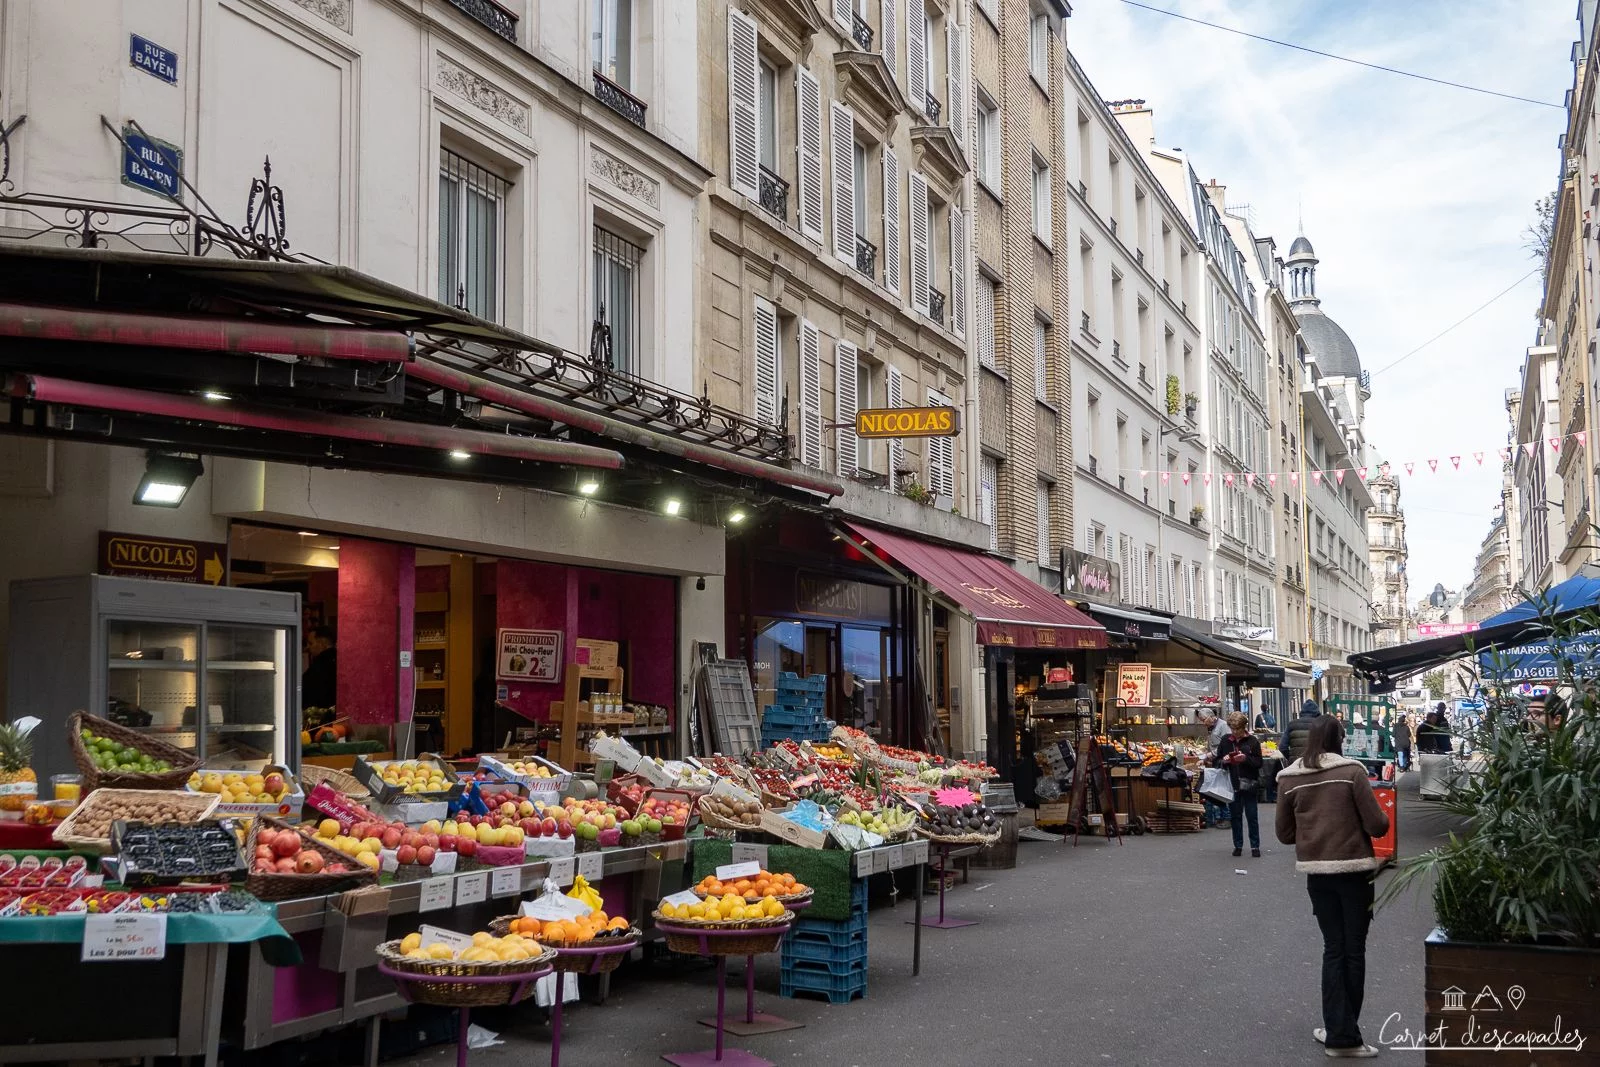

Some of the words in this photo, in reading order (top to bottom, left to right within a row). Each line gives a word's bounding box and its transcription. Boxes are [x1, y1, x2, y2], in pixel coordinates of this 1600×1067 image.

[144, 43, 166, 61] RUE
[135, 51, 174, 79] BAYEN
[141, 147, 164, 165] RUE
[860, 411, 951, 432] NICOLAS
[116, 544, 194, 566] NICOLAS
[505, 634, 554, 645] PROMOTION
[504, 645, 517, 654] Mini
[519, 646, 554, 655] Chou-Fleur
[529, 657, 539, 675] 2
[1127, 690, 1134, 703] 2
[89, 949, 105, 957] Les
[107, 948, 114, 956] 2
[116, 949, 138, 957] pour
[140, 946, 158, 956] 10€
